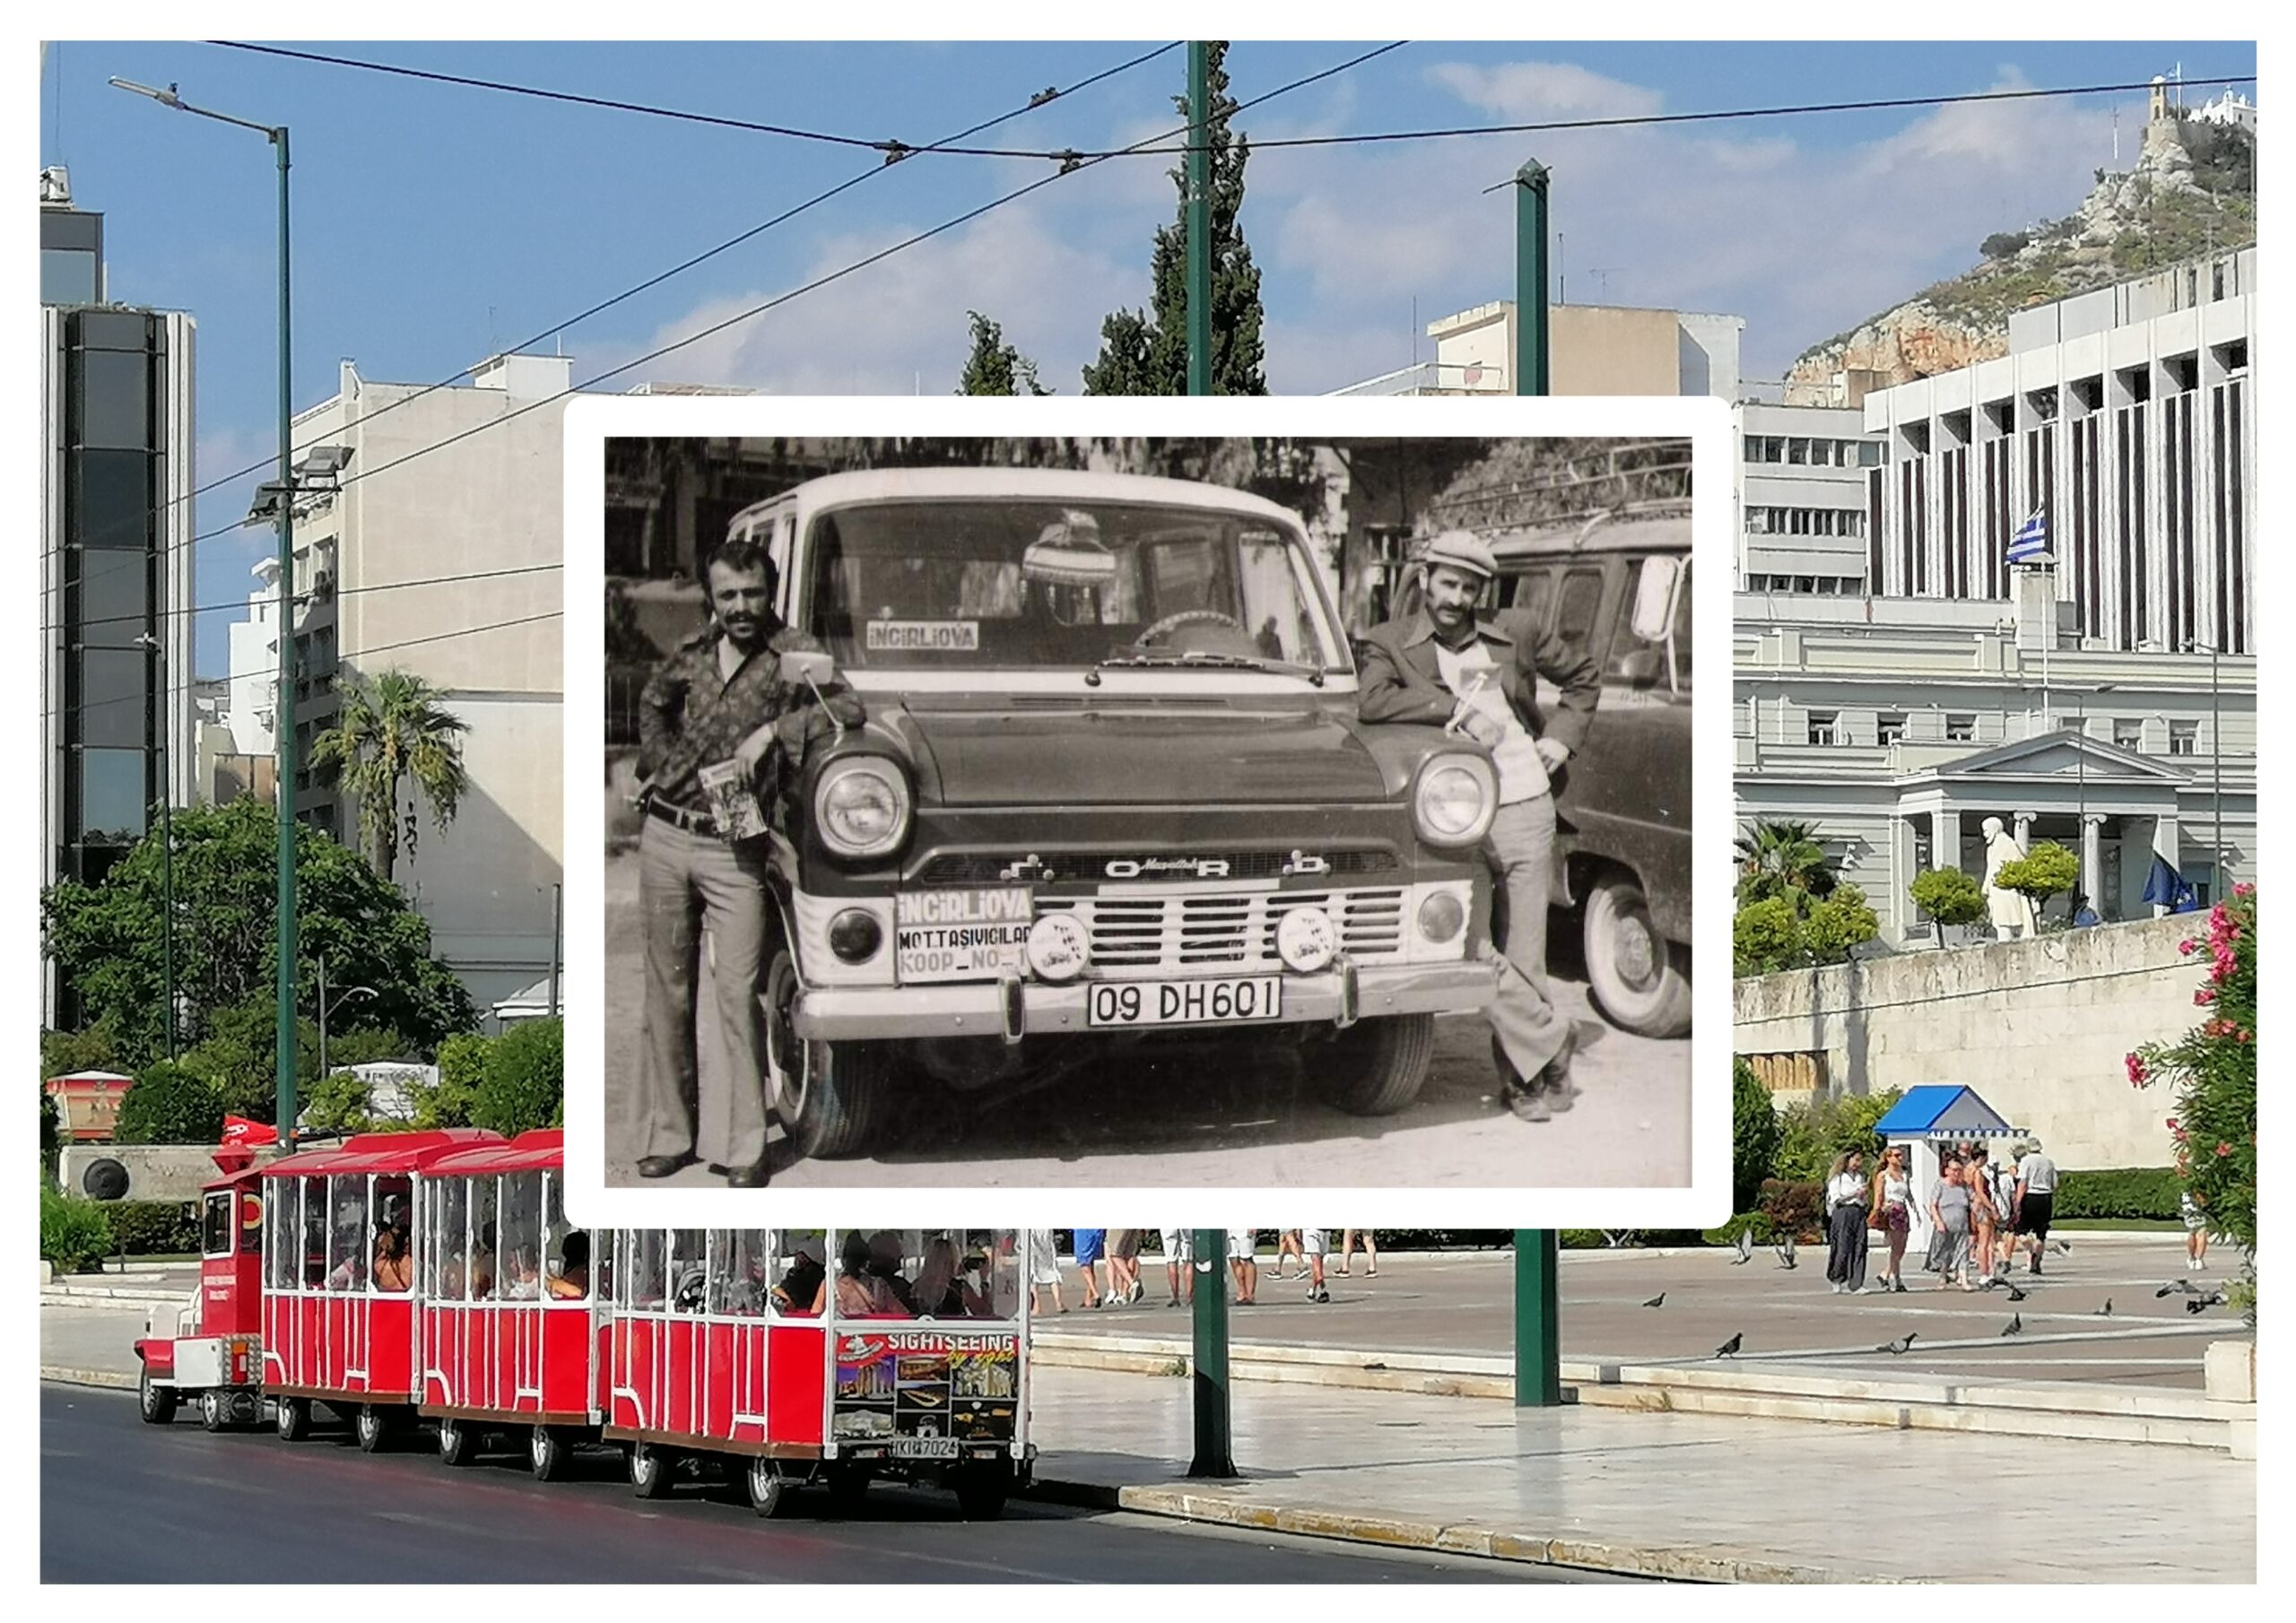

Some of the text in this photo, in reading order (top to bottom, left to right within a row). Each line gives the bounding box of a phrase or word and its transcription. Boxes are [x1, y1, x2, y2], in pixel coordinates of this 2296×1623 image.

[1097, 981, 1272, 1021] 09 DH601
[887, 1332, 1014, 1352] SIGHTSEEING
